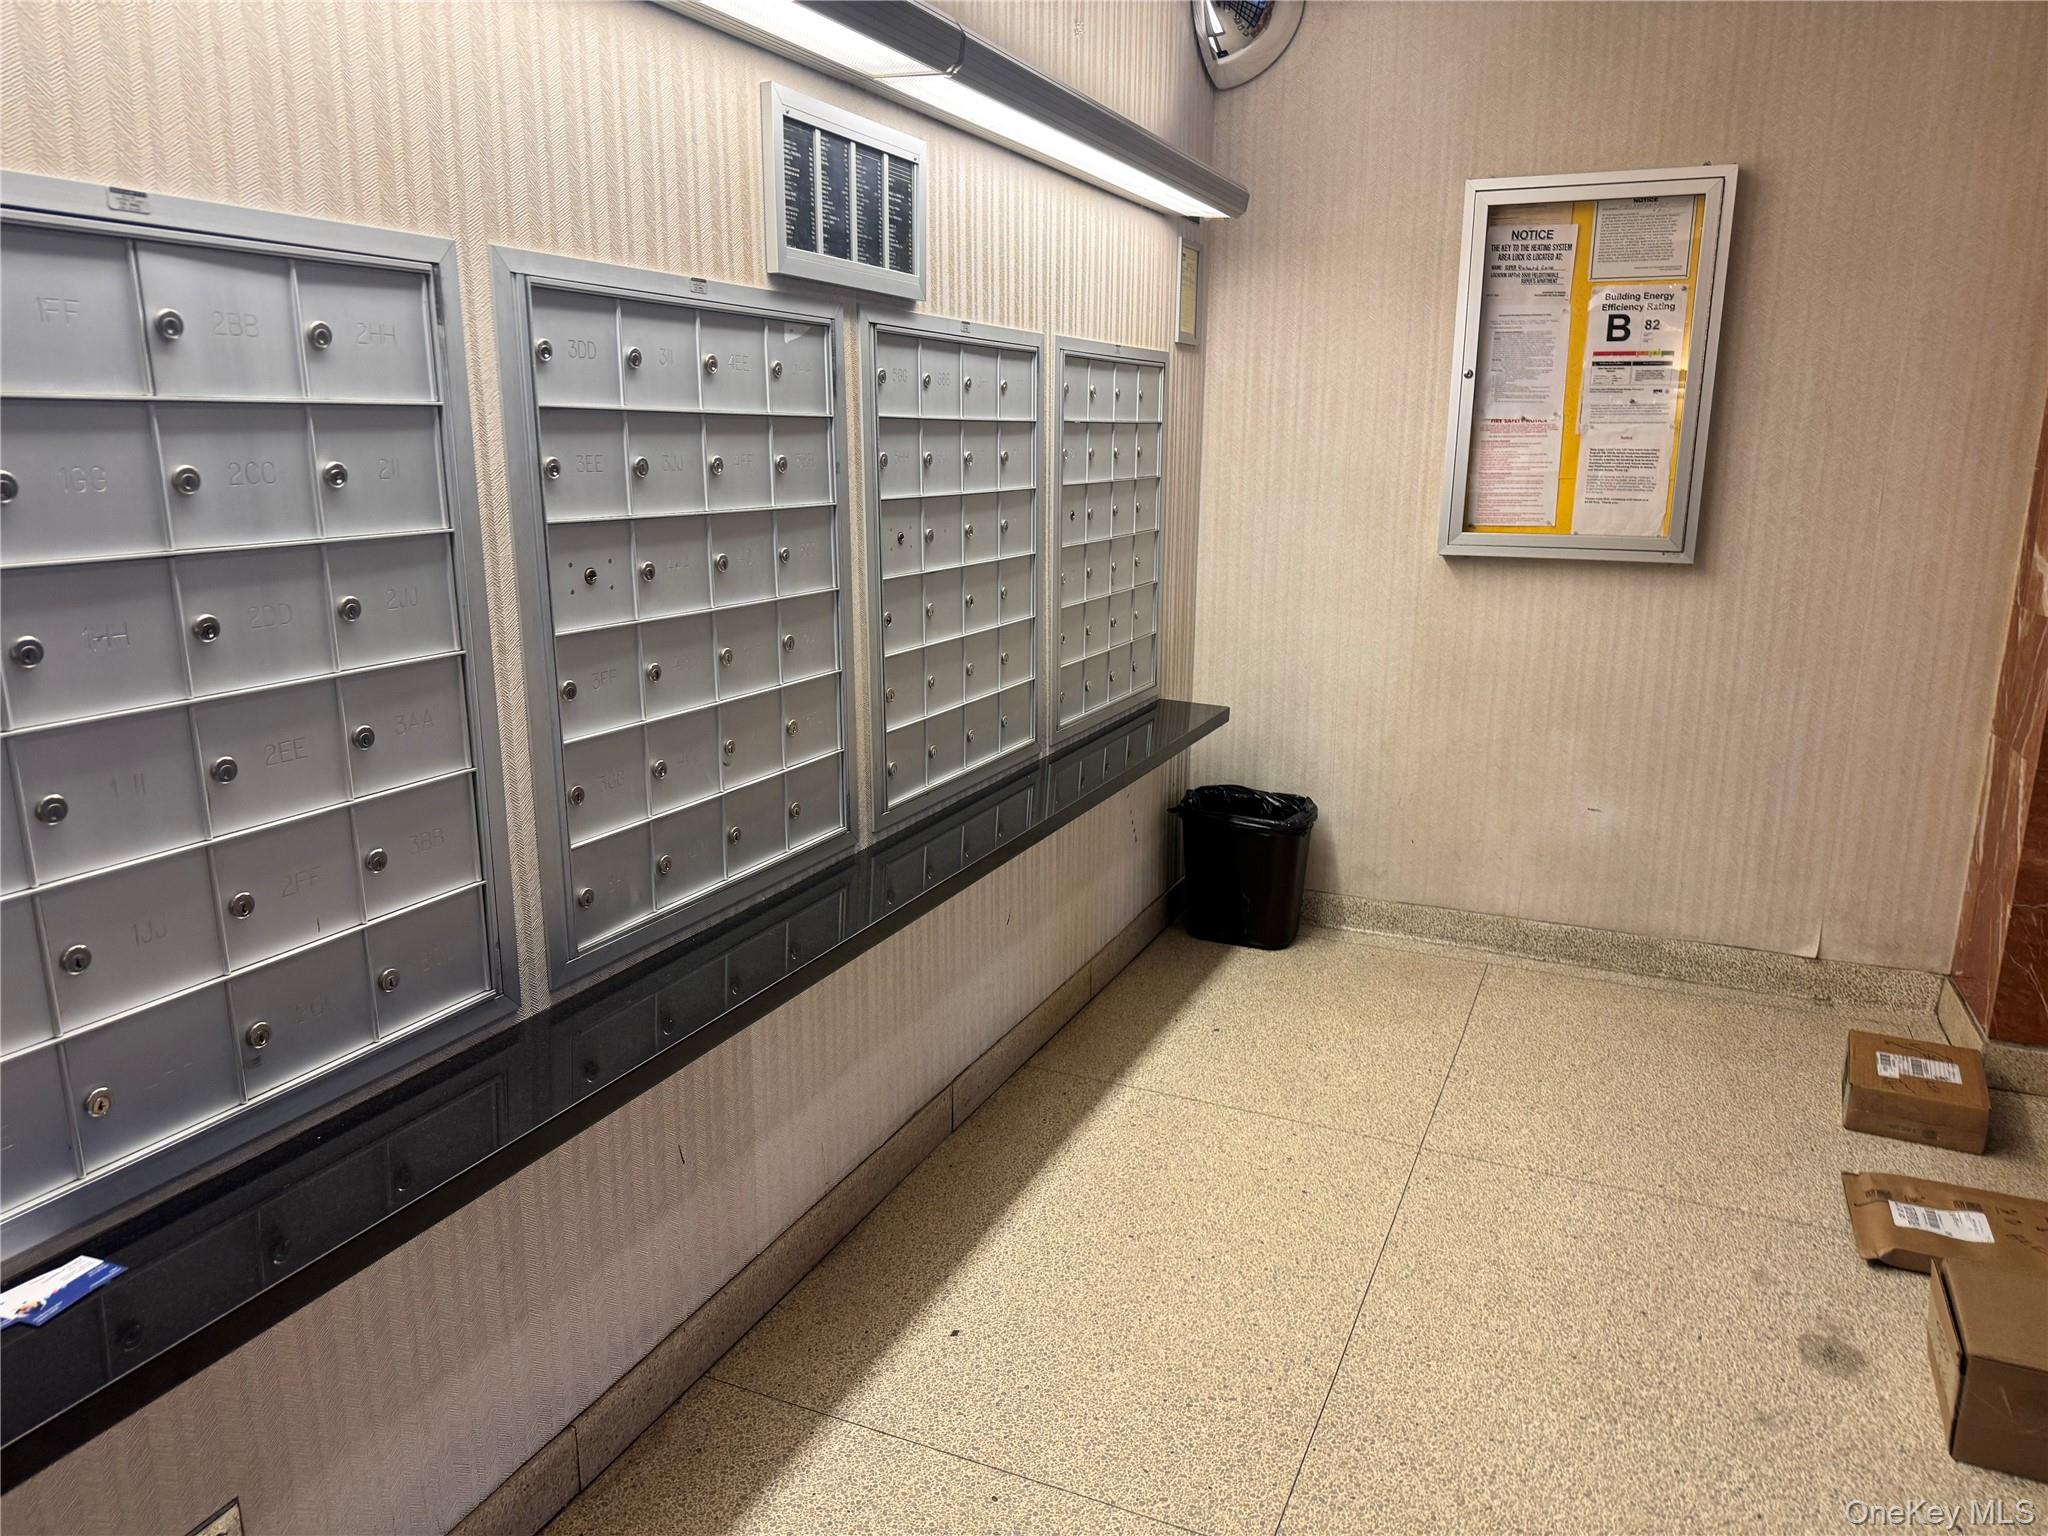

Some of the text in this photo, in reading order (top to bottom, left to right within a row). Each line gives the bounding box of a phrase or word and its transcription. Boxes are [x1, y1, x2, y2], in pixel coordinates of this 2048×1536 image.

[1511, 229, 1555, 240] NOTICE
[1491, 244, 1500, 252] THE
[1501, 244, 1511, 252] KEY
[1520, 244, 1530, 252] THE
[1552, 243, 1573, 251] SYSTEM
[1498, 253, 1511, 261] AREA
[1512, 253, 1525, 261] LOCK
[1601, 302, 1676, 312] Efficiency Rating
[1605, 291, 1675, 301] Building Energy
[35, 296, 81, 327] 1FF
[212, 310, 260, 338] 2BB
[353, 321, 397, 345] 2HH
[1606, 314, 1631, 342] B
[1644, 319, 1661, 330] 82
[567, 338, 598, 360] 3DD
[727, 352, 753, 372] 4EE
[227, 461, 277, 487] 2CC
[575, 453, 604, 473] 3EE
[58, 465, 107, 494] 1GG
[247, 602, 294, 629] 2DD
[81, 621, 131, 652] 1HH
[591, 668, 617, 690] 3FF
[263, 736, 309, 767] 2EE
[281, 865, 322, 897] 2FF
